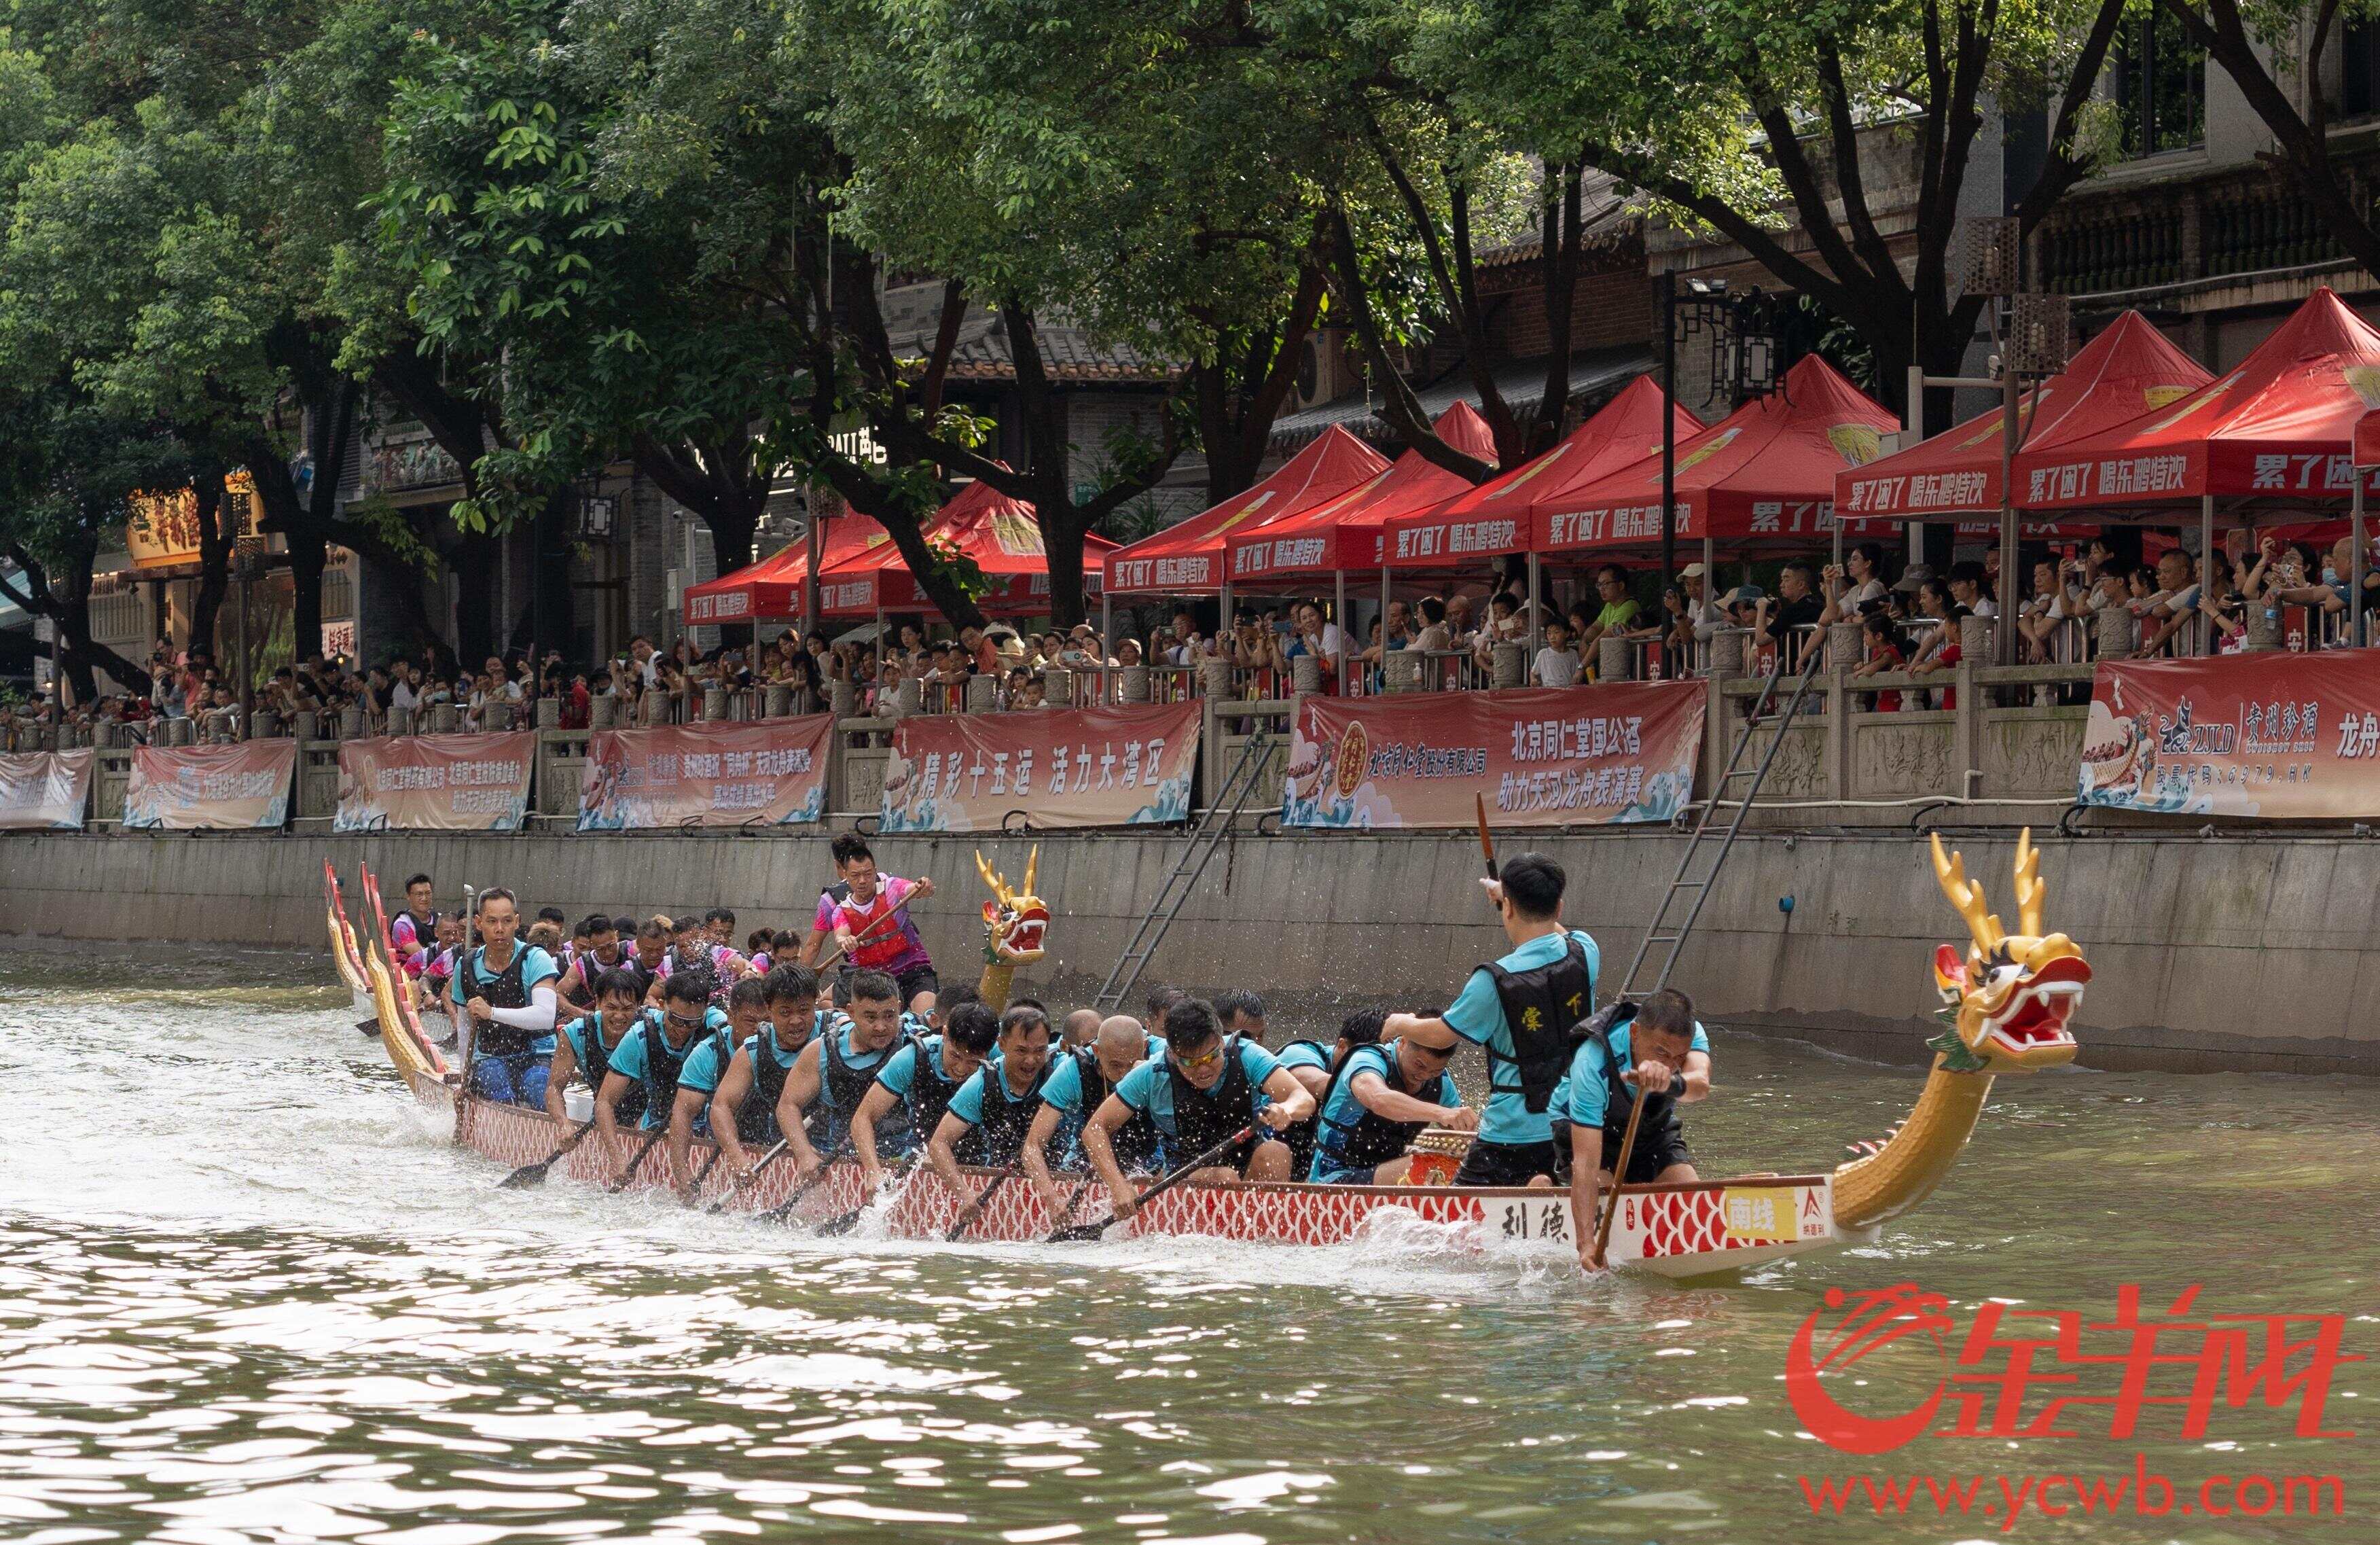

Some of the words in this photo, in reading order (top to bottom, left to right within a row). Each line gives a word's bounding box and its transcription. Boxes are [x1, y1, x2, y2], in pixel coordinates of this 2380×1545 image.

[2027, 463, 2093, 503] 累了困了
[2098, 455, 2186, 495] 喝东鹏特饮
[2252, 455, 2380, 489] 累了困
[1848, 477, 1905, 511] 累了困了
[1908, 472, 1987, 507] 喝东鹏特饮
[1549, 509, 1608, 544] 累了困了
[1750, 501, 1868, 532] 累了困
[1235, 541, 1272, 574] 累了困了
[1274, 537, 1325, 567] 喝东鹏特饮
[1396, 525, 1445, 558] 累了困了
[1449, 519, 1515, 553] 喝东鹏特饮
[1115, 560, 1153, 587] 累了困了
[1157, 557, 1209, 586] 喝东鹏特饮
[1511, 716, 1642, 761] 北京同仁堂国公酒
[2192, 724, 2236, 755] ZJLD
[920, 749, 1033, 798] 精彩十五运
[1049, 739, 1166, 794] 活力大湾区
[1367, 742, 1488, 779] 北京同仁堂股份有限公司
[1497, 764, 1644, 811] 助力天河龙舟表演赛
[1729, 1197, 1775, 1232] 南线
